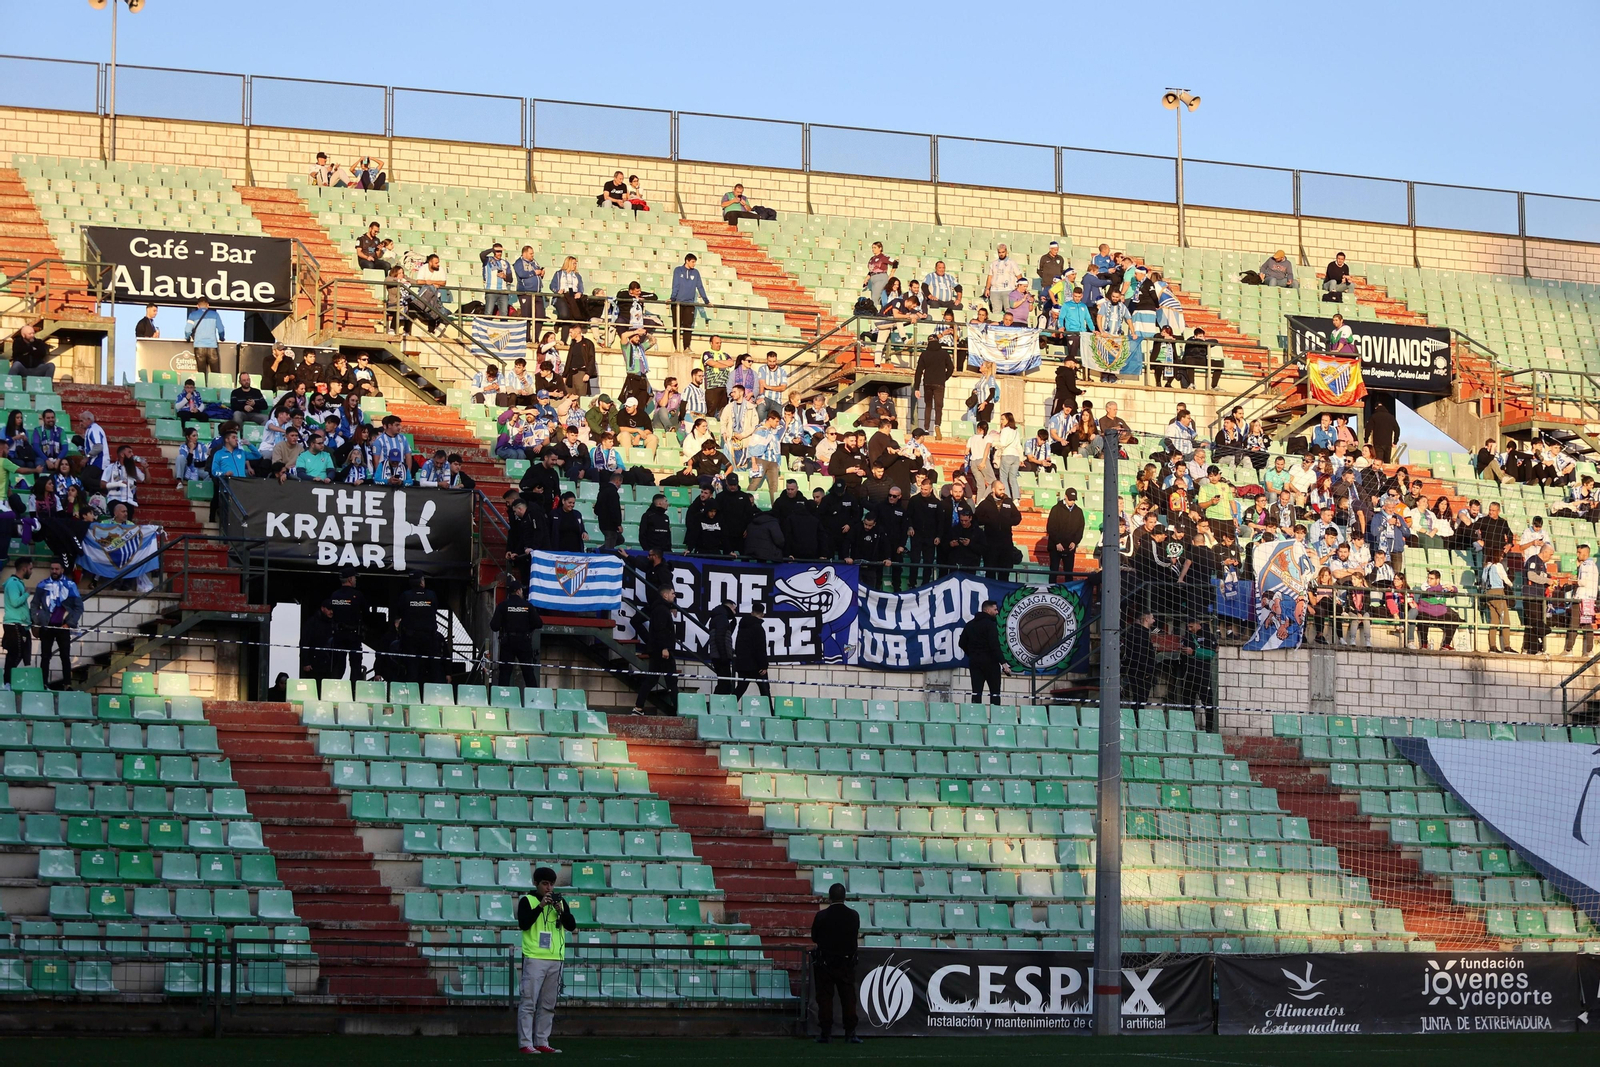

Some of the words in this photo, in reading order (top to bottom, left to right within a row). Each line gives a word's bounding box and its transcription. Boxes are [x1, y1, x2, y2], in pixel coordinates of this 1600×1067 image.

[129, 236, 189, 260] Café
[210, 241, 256, 265] Bar
[105, 264, 276, 304] Alaudae
[1350, 333, 1431, 367] GOVIANOS
[311, 487, 387, 516] THE
[266, 512, 388, 542] KRAFT
[316, 541, 387, 569] BAR
[708, 571, 768, 614] DE
[1050, 628, 1075, 661] FTBOL
[1460, 957, 1525, 969] fundación
[926, 964, 1165, 1012] CESPX
[927, 1014, 983, 1028] Instalación
[985, 1018, 991, 1030] y
[994, 1016, 1071, 1029] mantenimiento
[1073, 1016, 1086, 1029] de
[1126, 1016, 1166, 1029] artificial
[1264, 1003, 1346, 1018] Alimentos
[1420, 1016, 1453, 1033] JUNTA
[1456, 1016, 1471, 1030] DE
[1475, 1015, 1553, 1030] EXTREMADURA
[1248, 1024, 1261, 1035] de
[1260, 1019, 1361, 1034] Extremadura
